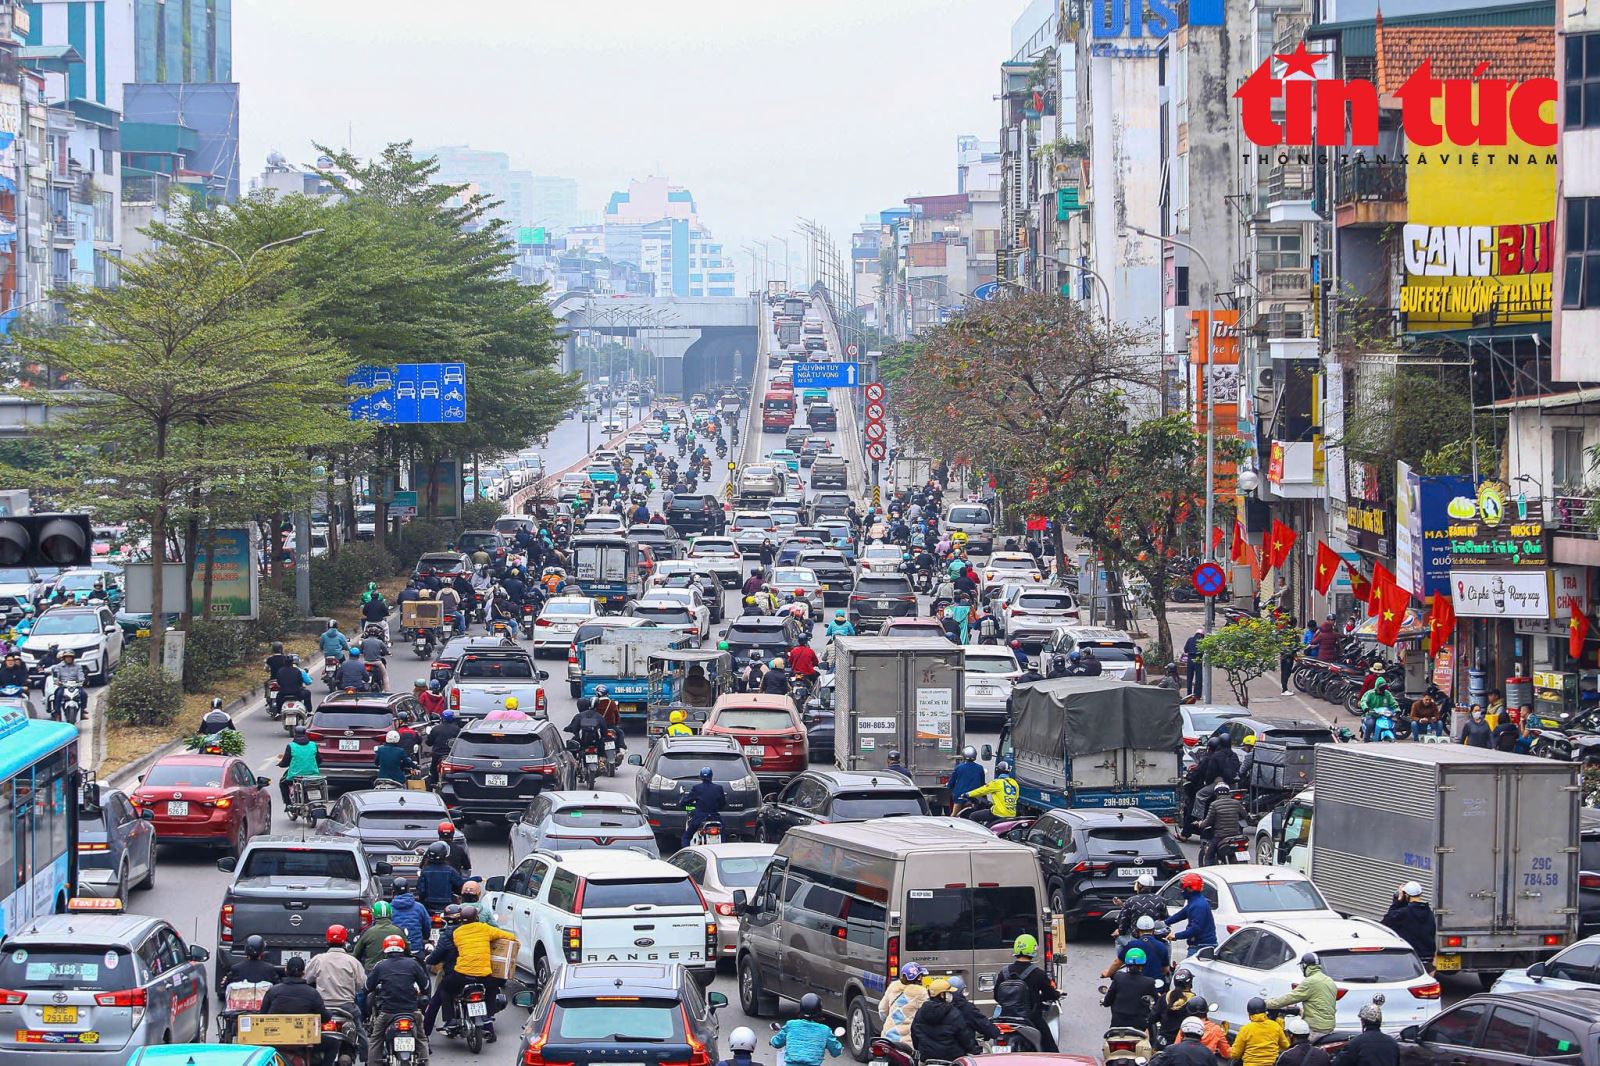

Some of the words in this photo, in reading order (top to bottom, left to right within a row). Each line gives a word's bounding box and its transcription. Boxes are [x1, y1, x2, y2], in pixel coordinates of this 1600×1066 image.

[1400, 286, 1451, 313] BUFFET
[1451, 277, 1498, 313] NƯỚNG
[1562, 572, 1577, 590] TRÀ
[1467, 584, 1478, 601] Cà
[1508, 585, 1527, 608] Rang
[1526, 591, 1541, 608] xay
[1532, 857, 1552, 870] 29C
[1523, 873, 1558, 886] 784.58
[73, 899, 92, 907] Taxi
[94, 899, 116, 907] 123
[587, 951, 700, 962] RANGER
[47, 1014, 74, 1023] 793.60
